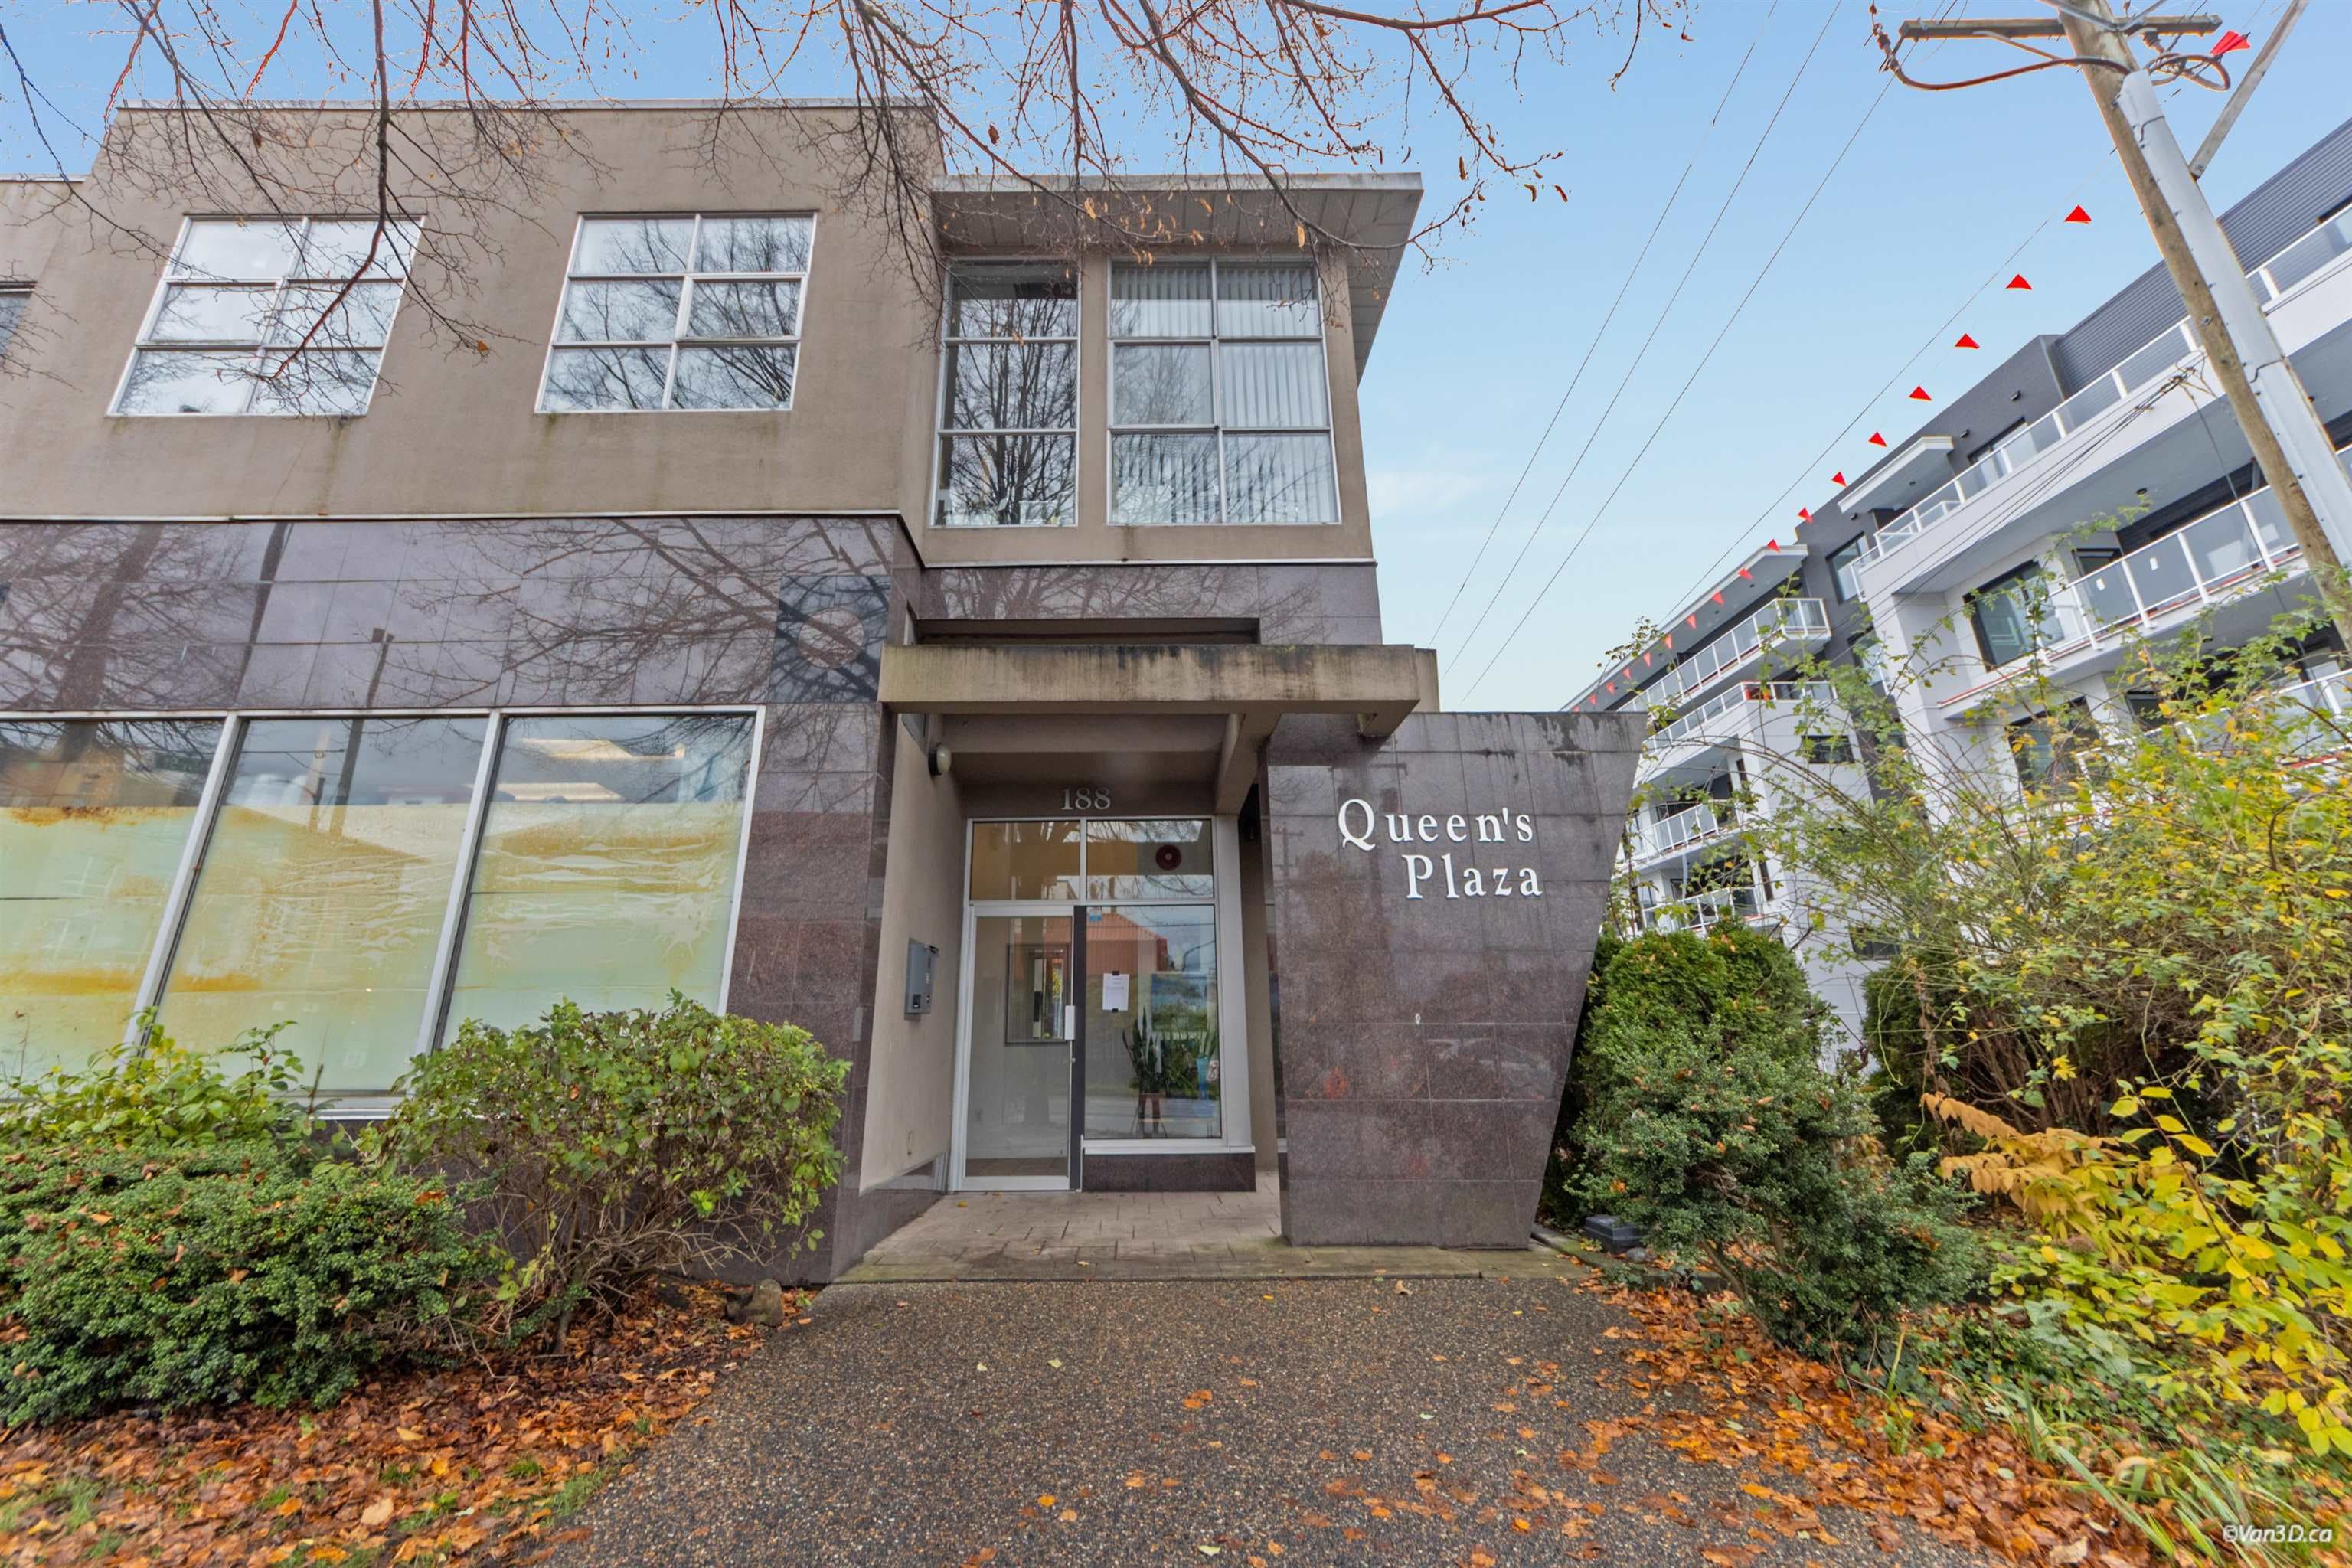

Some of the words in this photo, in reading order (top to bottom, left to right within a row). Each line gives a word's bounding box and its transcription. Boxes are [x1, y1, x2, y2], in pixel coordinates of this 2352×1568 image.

[1060, 787, 1111, 810] 188
[1338, 798, 1534, 851] Queen's
[1401, 852, 1543, 900] Plaza
